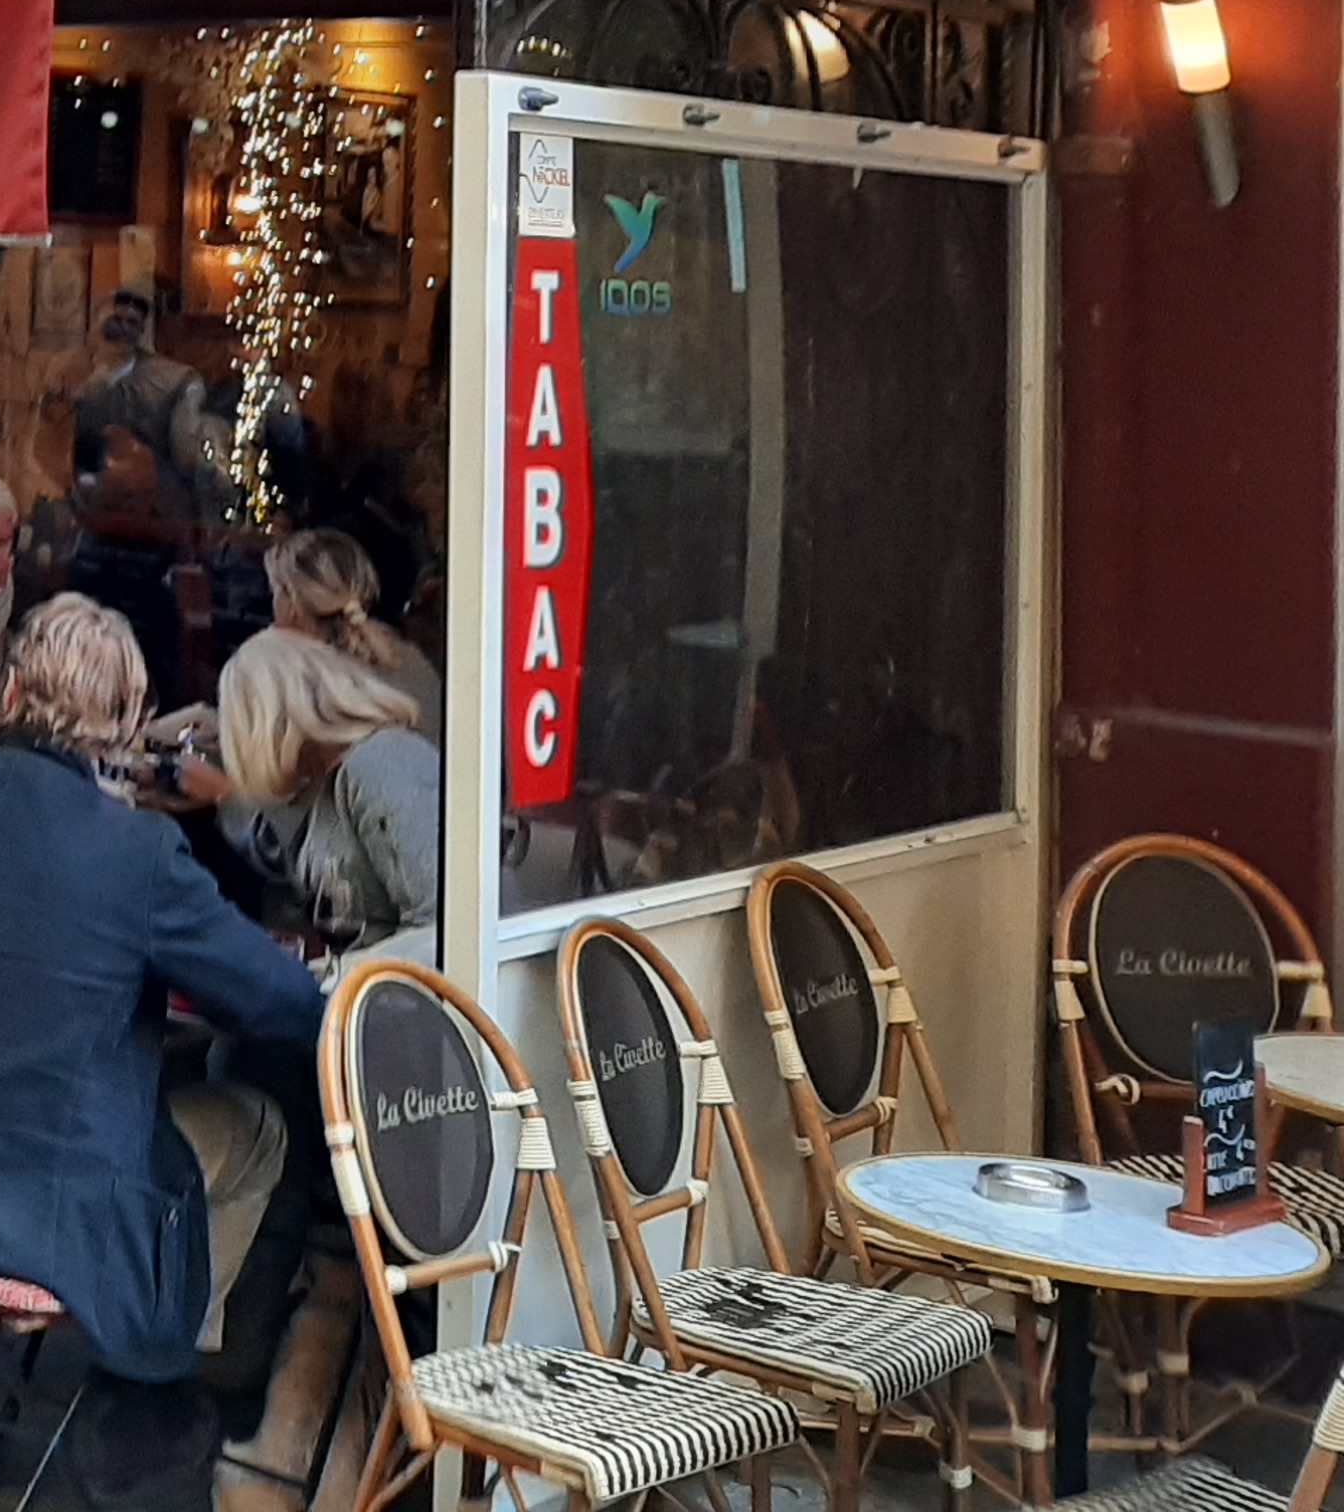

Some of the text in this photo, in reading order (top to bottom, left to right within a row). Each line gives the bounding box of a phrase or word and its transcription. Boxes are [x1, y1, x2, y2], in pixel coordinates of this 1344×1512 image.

[599, 278, 672, 317] IQOS
[520, 268, 566, 770] TABAC
[1114, 947, 1254, 978] La Civette
[376, 1085, 480, 1133] La Civette
